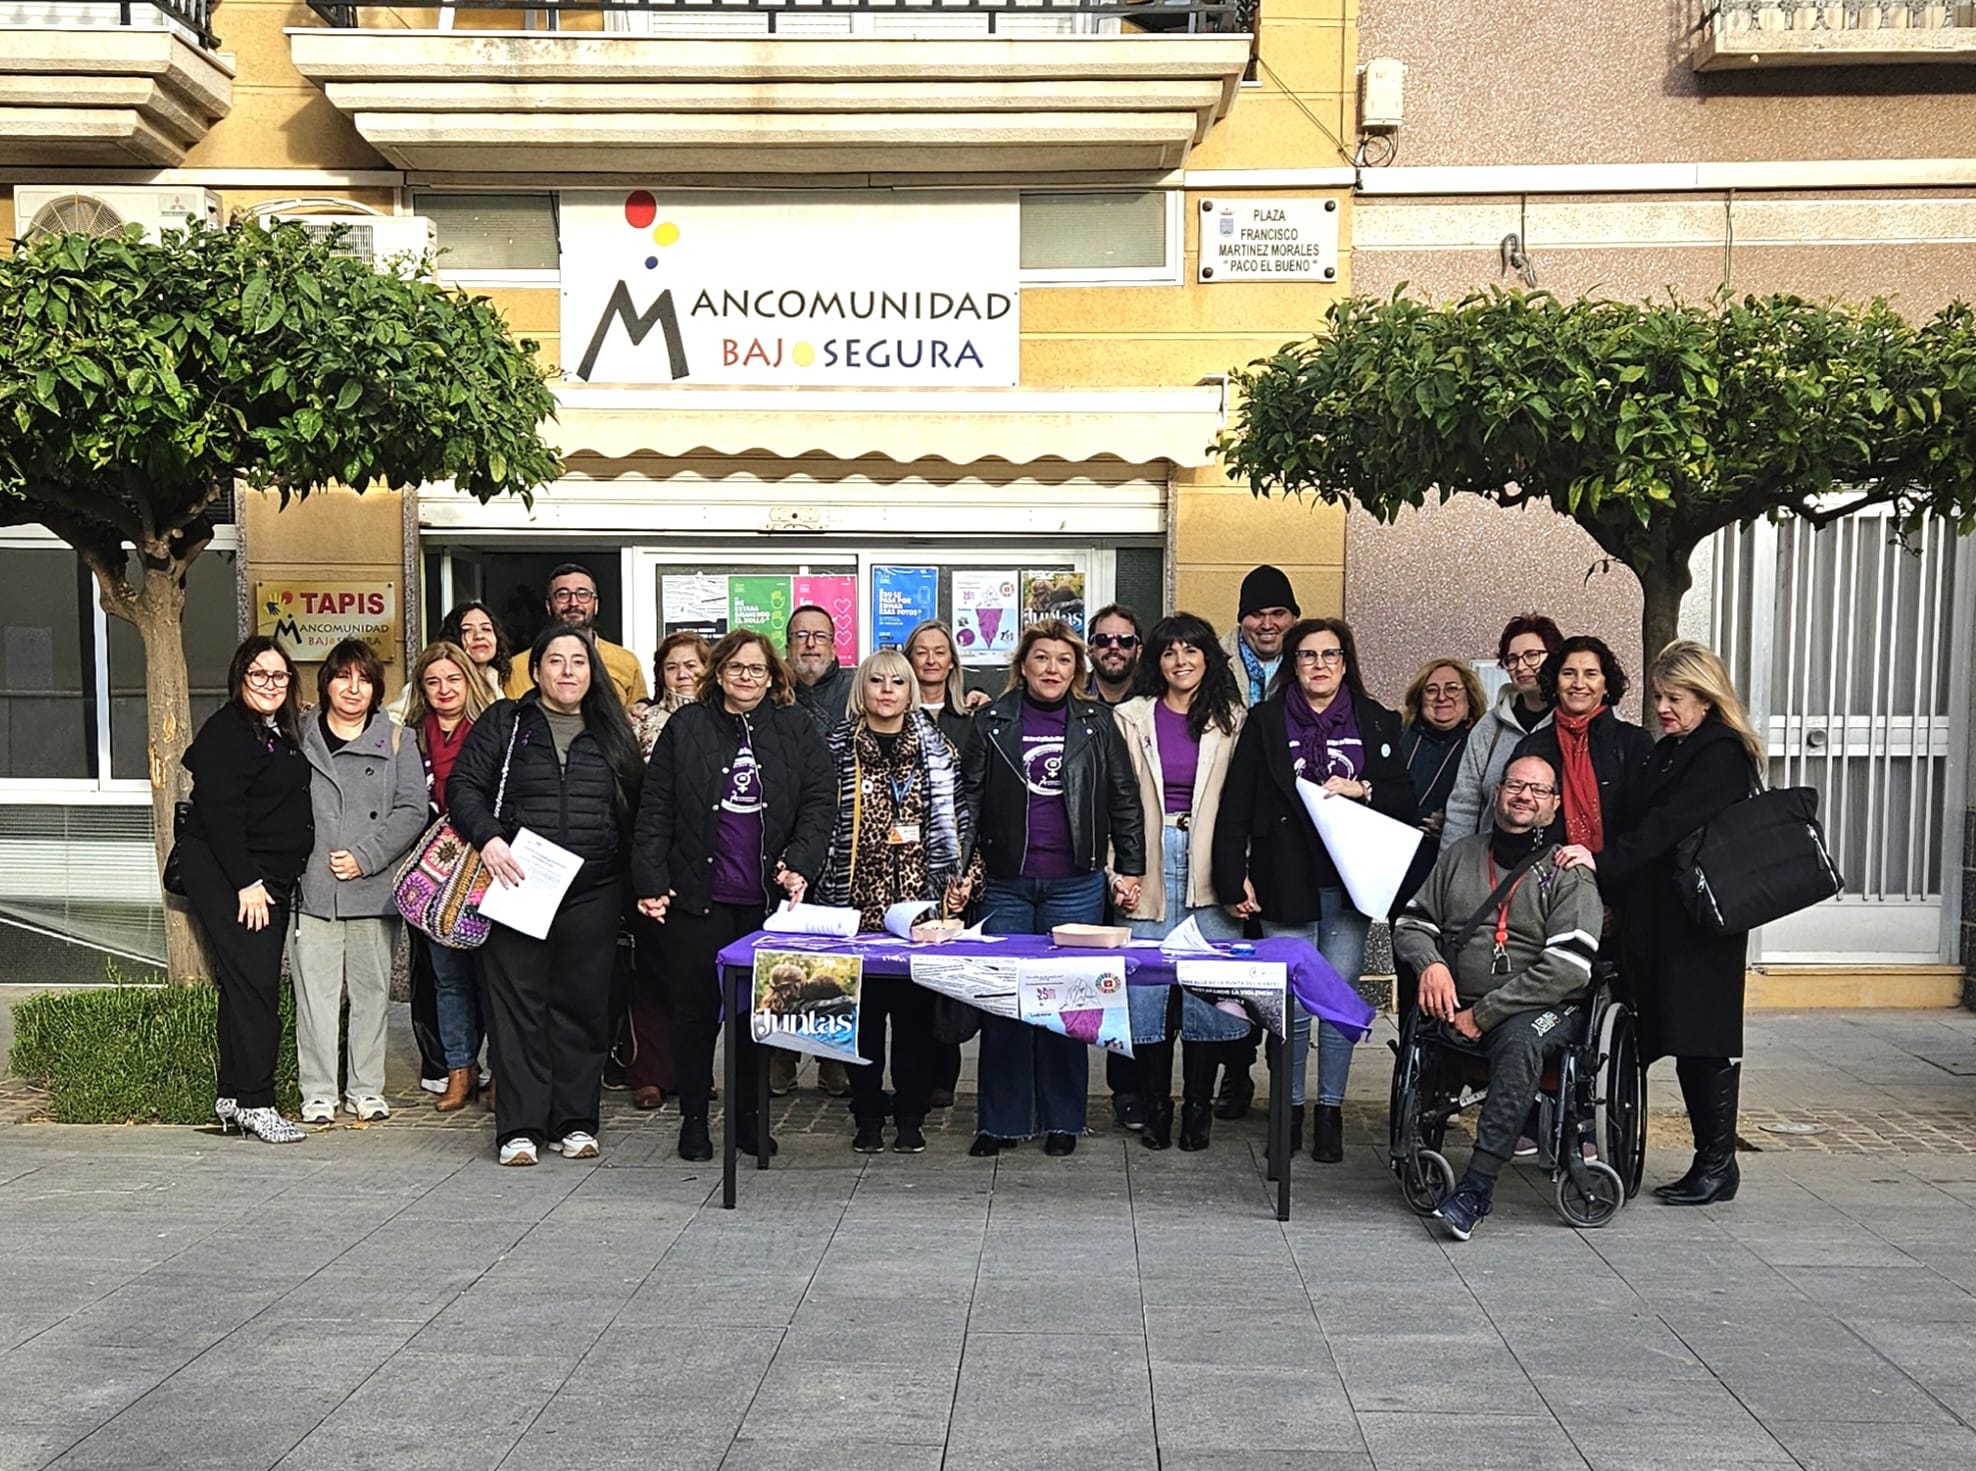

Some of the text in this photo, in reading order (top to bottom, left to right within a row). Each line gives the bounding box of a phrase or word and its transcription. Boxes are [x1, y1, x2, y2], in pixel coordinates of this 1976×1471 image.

[1253, 209, 1286, 222] PLAZA
[1240, 228, 1298, 240] FRANCISCO
[1219, 244, 1320, 256] MARTINEZ MORALES
[1230, 260, 1258, 272] PACO
[1260, 260, 1272, 272] EL
[1275, 259, 1310, 272] BUENO
[576, 279, 1011, 382] MANCOMUNIDAD
[823, 338, 984, 368] SEGURA
[300, 592, 385, 615] TAPIS
[274, 619, 389, 644] MANCOMUNIDAD
[757, 1008, 854, 1035] Juntas
